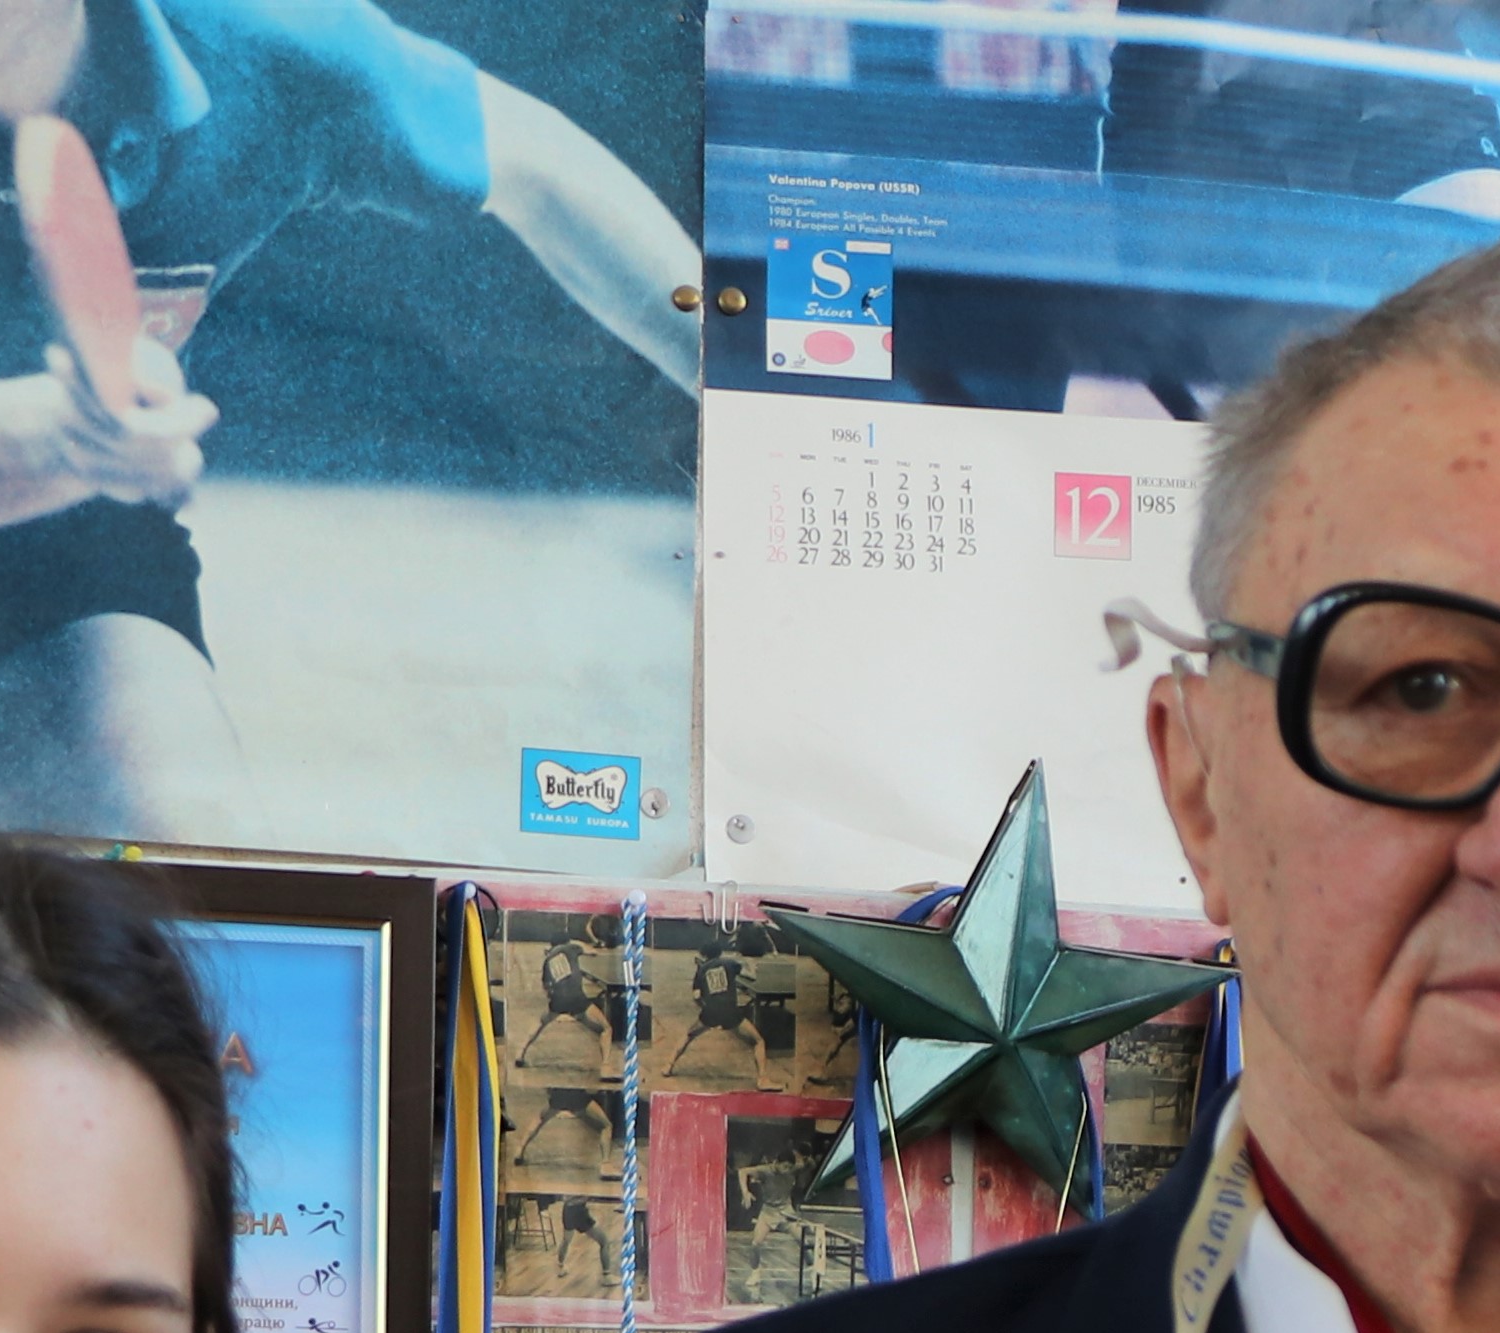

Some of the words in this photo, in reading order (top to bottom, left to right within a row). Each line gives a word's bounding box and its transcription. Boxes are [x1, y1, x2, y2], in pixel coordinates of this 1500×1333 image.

[768, 174, 827, 188] Valentina
[831, 178, 875, 192] Popova
[879, 181, 920, 196] (USSR)
[796, 208, 839, 223] European
[796, 220, 840, 234] European
[811, 250, 853, 299] S
[804, 302, 854, 320] Sriver
[831, 427, 862, 444] 1986
[867, 423, 875, 449] 1
[1064, 486, 1122, 548] 12
[1136, 476, 1198, 490] DECEMBER
[1137, 496, 1176, 514] 1985
[798, 548, 819, 566] 27
[830, 549, 852, 567] 28
[862, 550, 885, 568] 29
[894, 553, 915, 571] 30
[928, 555, 945, 573] 31
[545, 774, 616, 804] Butterfly
[530, 812, 579, 826] TAMASU
[586, 817, 630, 830] EUROPA
